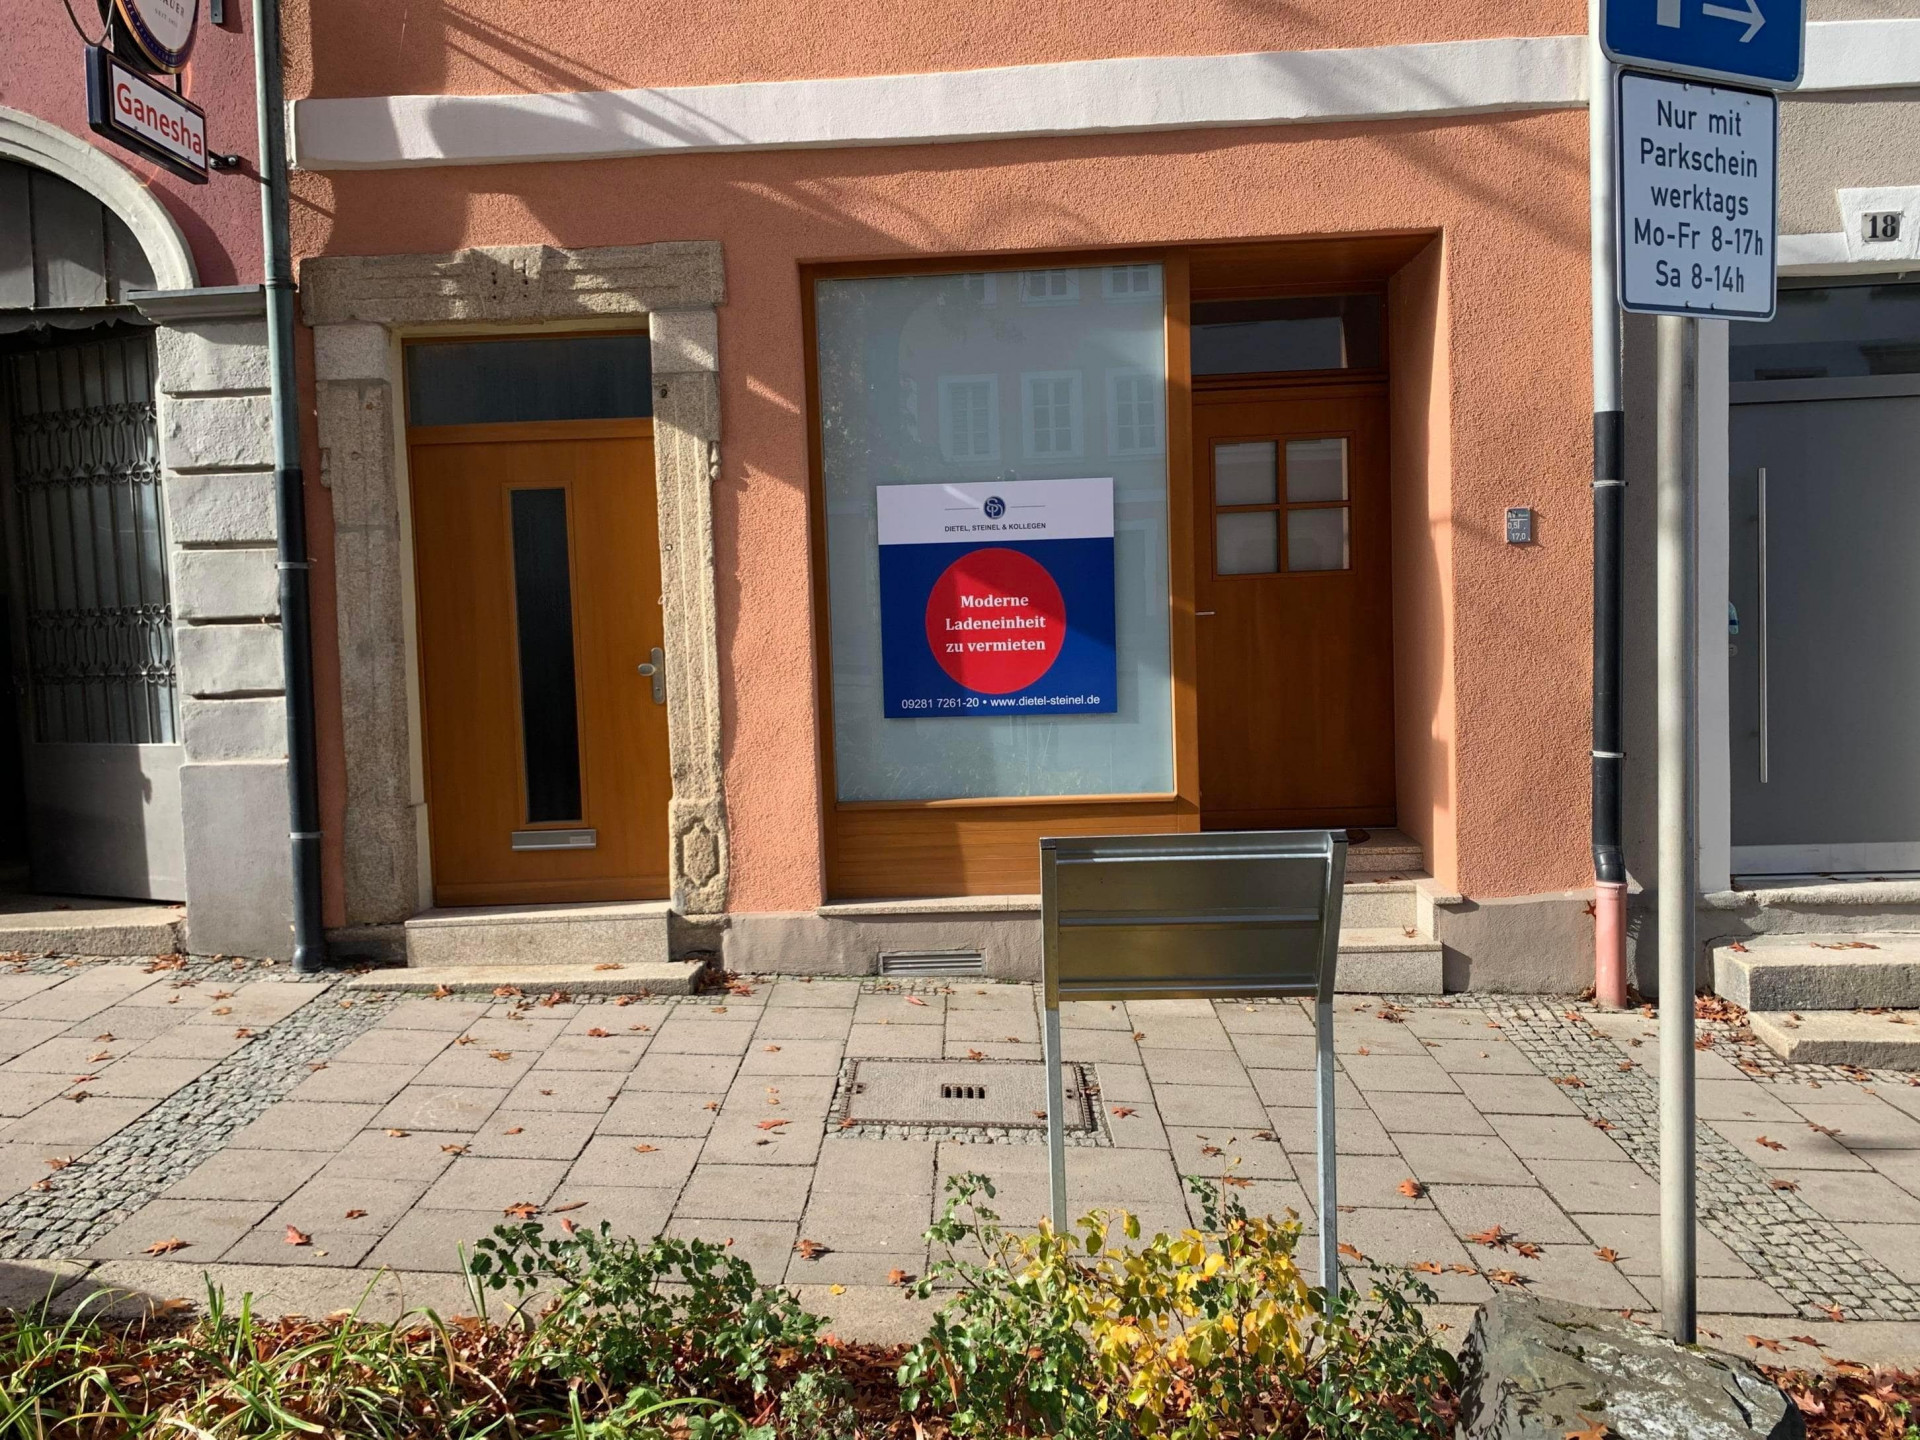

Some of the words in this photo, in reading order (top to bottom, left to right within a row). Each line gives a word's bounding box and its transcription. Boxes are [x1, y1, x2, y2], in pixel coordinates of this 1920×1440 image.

[117, 83, 202, 156] Ganesha
[1657, 99, 1698, 130] Nur
[1708, 109, 1742, 137] mit
[1640, 137, 1758, 178] Parkschein
[1651, 183, 1749, 221] werktags
[1634, 217, 1701, 250] Mo-Fr
[1711, 225, 1764, 256] 8-17h
[1868, 214, 1897, 239] 18
[1655, 259, 1681, 288] Sa
[1691, 263, 1745, 293] 8-14h
[944, 525, 971, 533] DIETEL,
[972, 524, 1000, 532] STEINEL
[1009, 522, 1047, 530] KOLLEGEN
[960, 594, 1029, 608] Moderne
[945, 615, 1046, 631] Ladeneinheit
[945, 642, 964, 653] zu
[967, 638, 1046, 653] vermieten
[901, 699, 933, 709] 09281
[937, 697, 980, 708] 7261-20
[990, 694, 1100, 707] www.dietel-steinel.de
